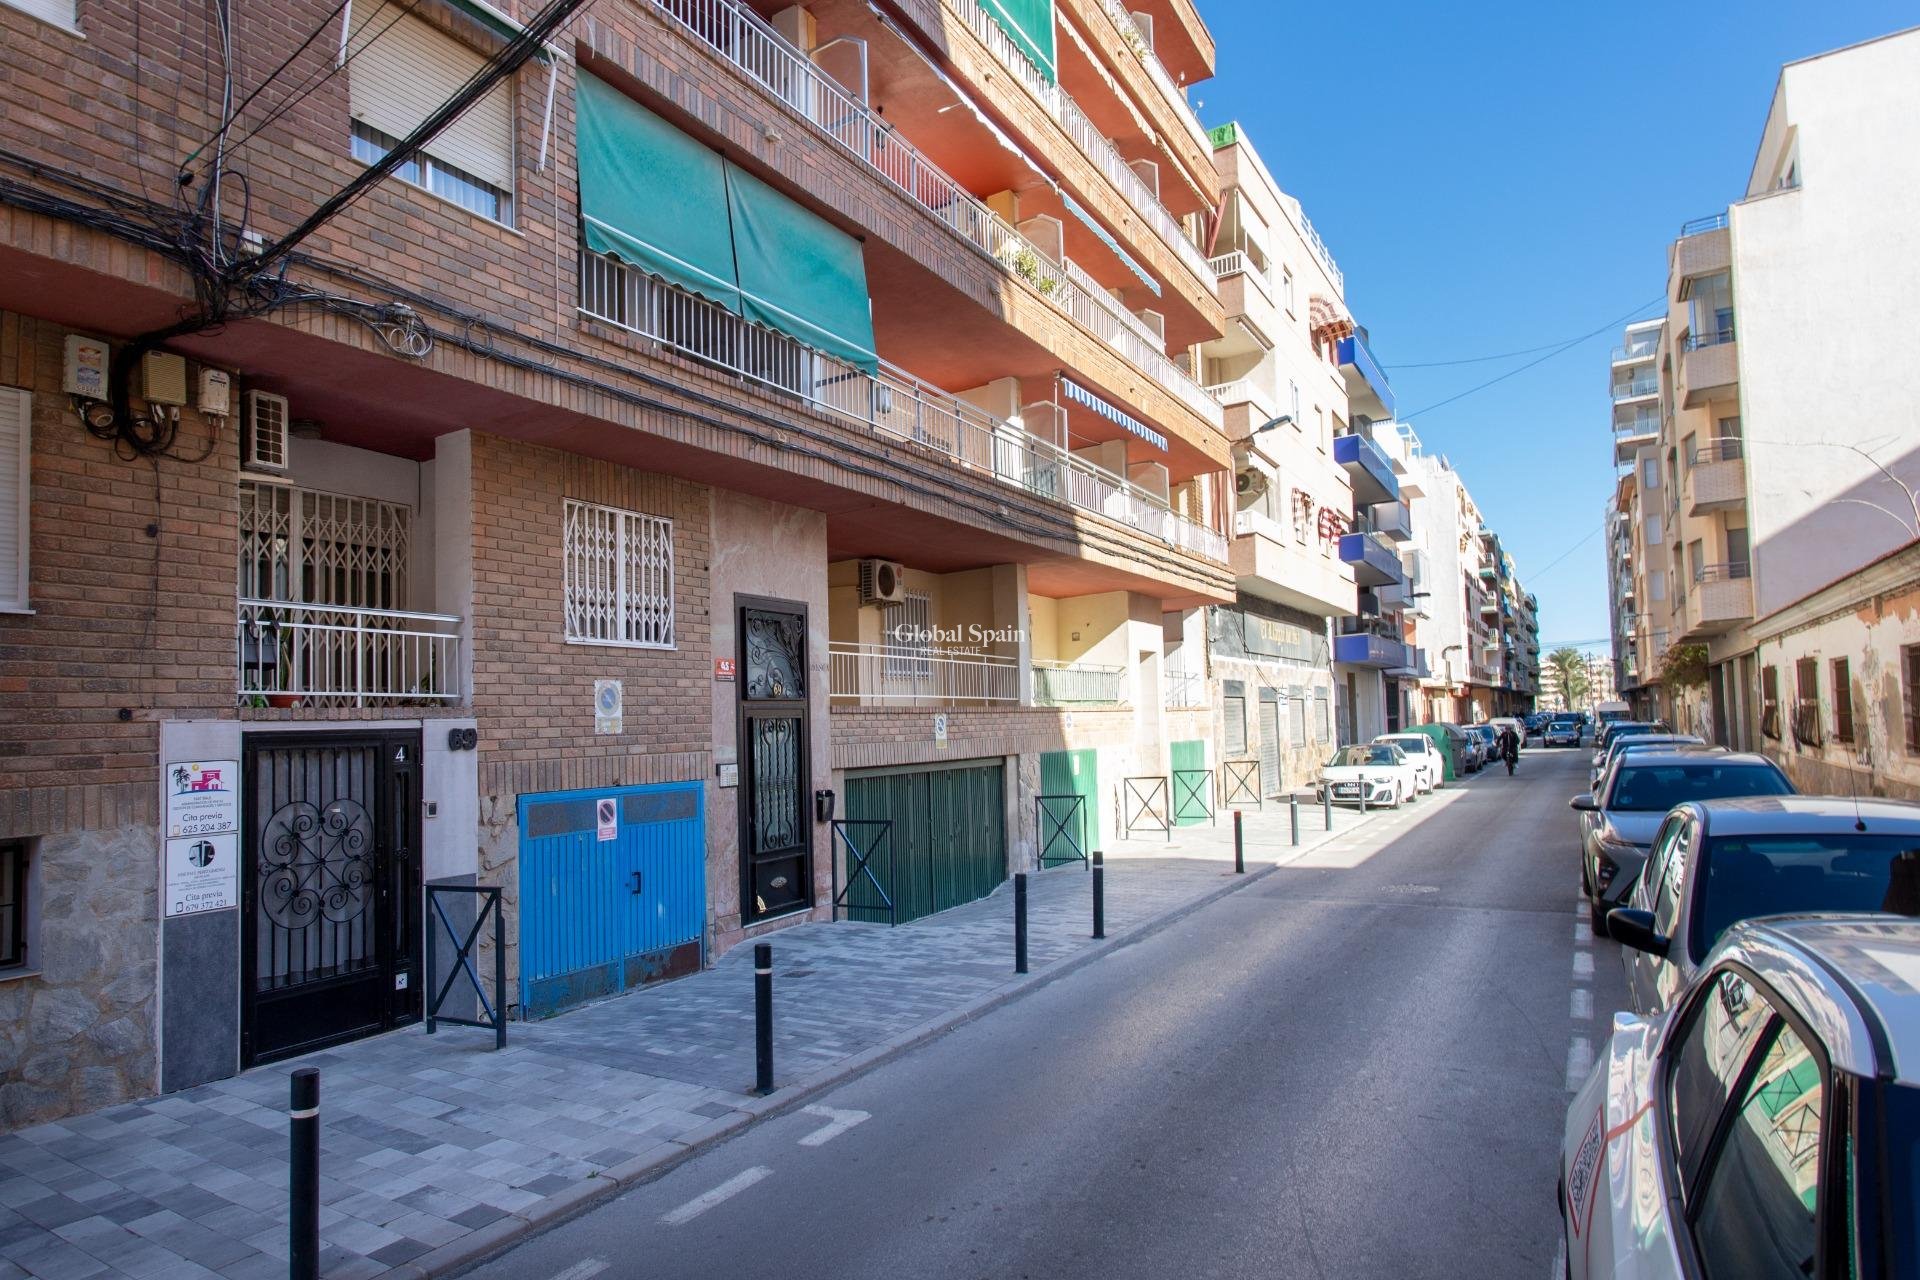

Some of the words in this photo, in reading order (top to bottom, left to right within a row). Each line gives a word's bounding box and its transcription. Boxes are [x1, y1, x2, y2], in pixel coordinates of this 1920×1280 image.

[448, 728, 478, 751] 69
[395, 746, 405, 762] 4
[182, 813, 198, 822] Cita
[199, 812, 223, 822] previa
[182, 825, 198, 834] 625
[200, 823, 215, 833] 204
[217, 821, 232, 831] 387
[185, 893, 200, 902] Cita
[201, 891, 223, 901] previa
[200, 901, 214, 910] 372
[214, 899, 227, 907] 421
